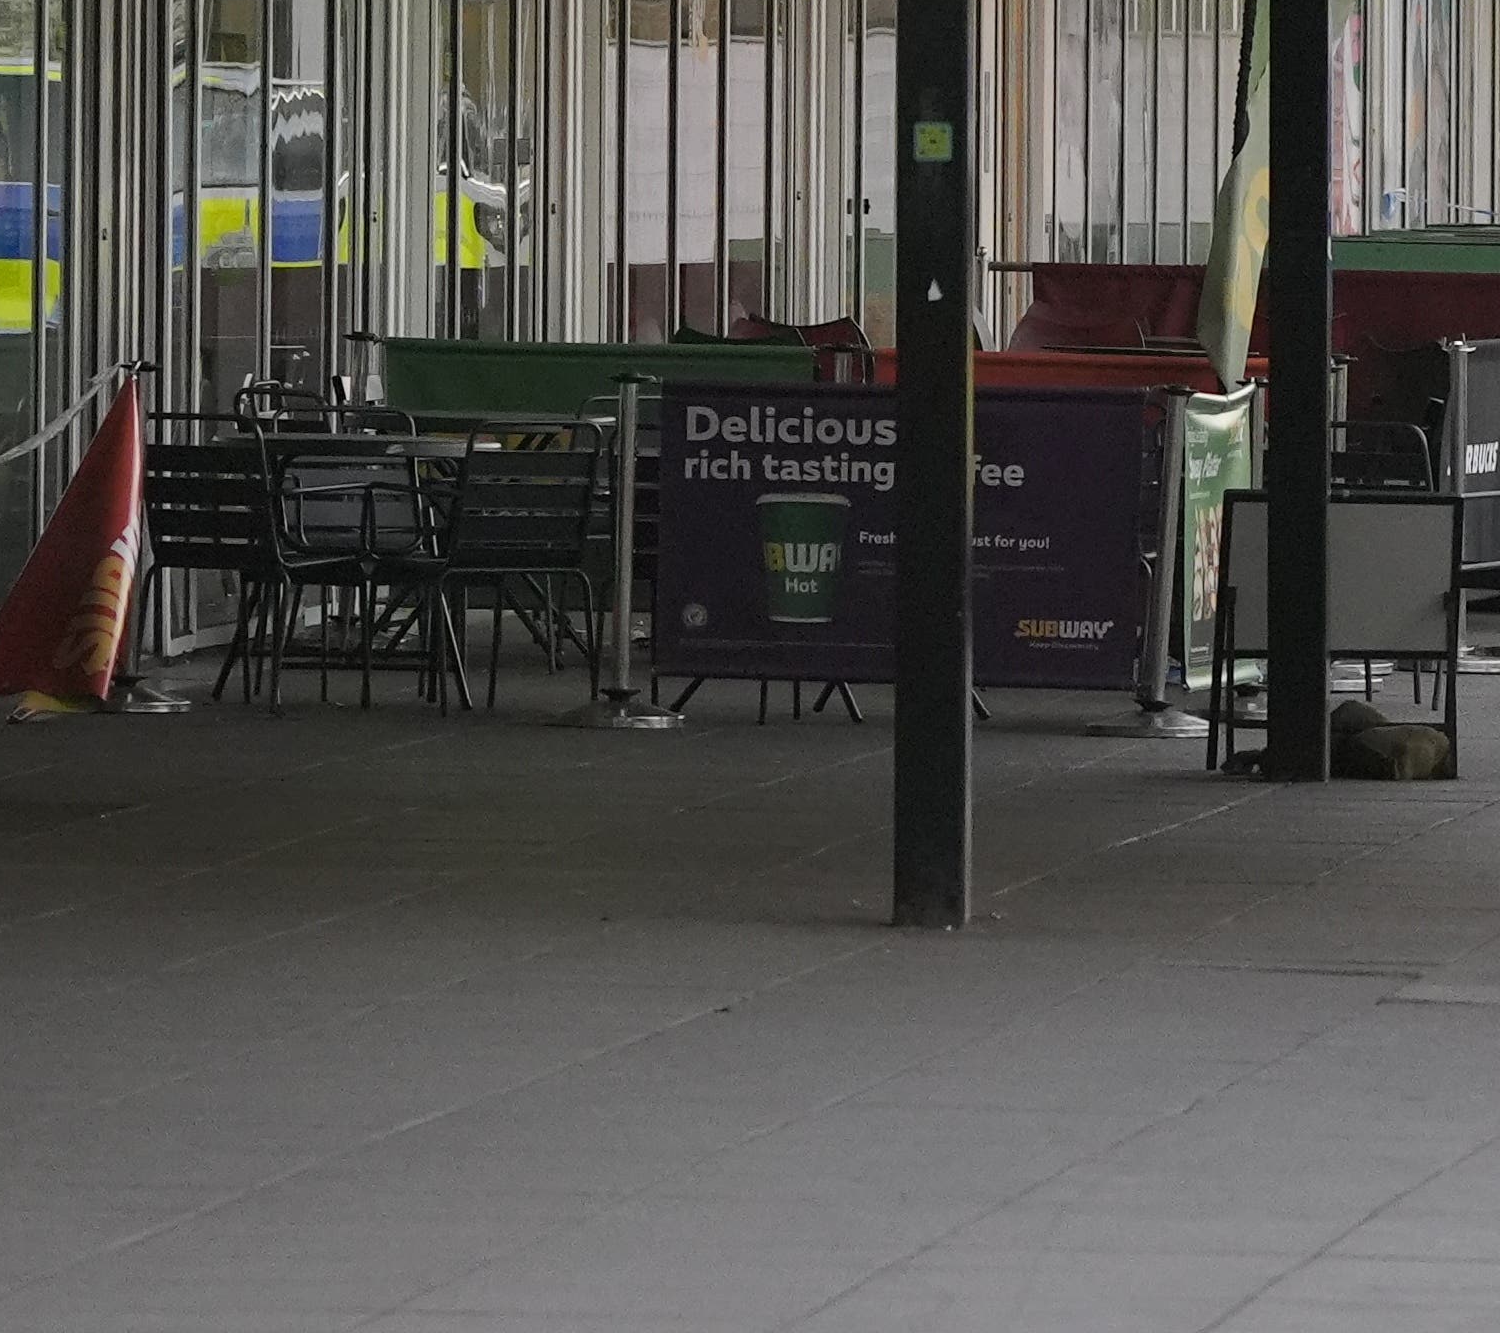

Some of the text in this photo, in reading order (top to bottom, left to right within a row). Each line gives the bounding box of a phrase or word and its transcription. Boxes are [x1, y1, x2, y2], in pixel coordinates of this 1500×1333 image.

[686, 405, 898, 446] Delicious
[684, 449, 751, 480] rich
[762, 452, 896, 491] tasting
[995, 535, 1016, 548] for
[1019, 536, 1050, 551] you!
[785, 577, 818, 593] Hot
[1013, 619, 1115, 639] SUBWAY
